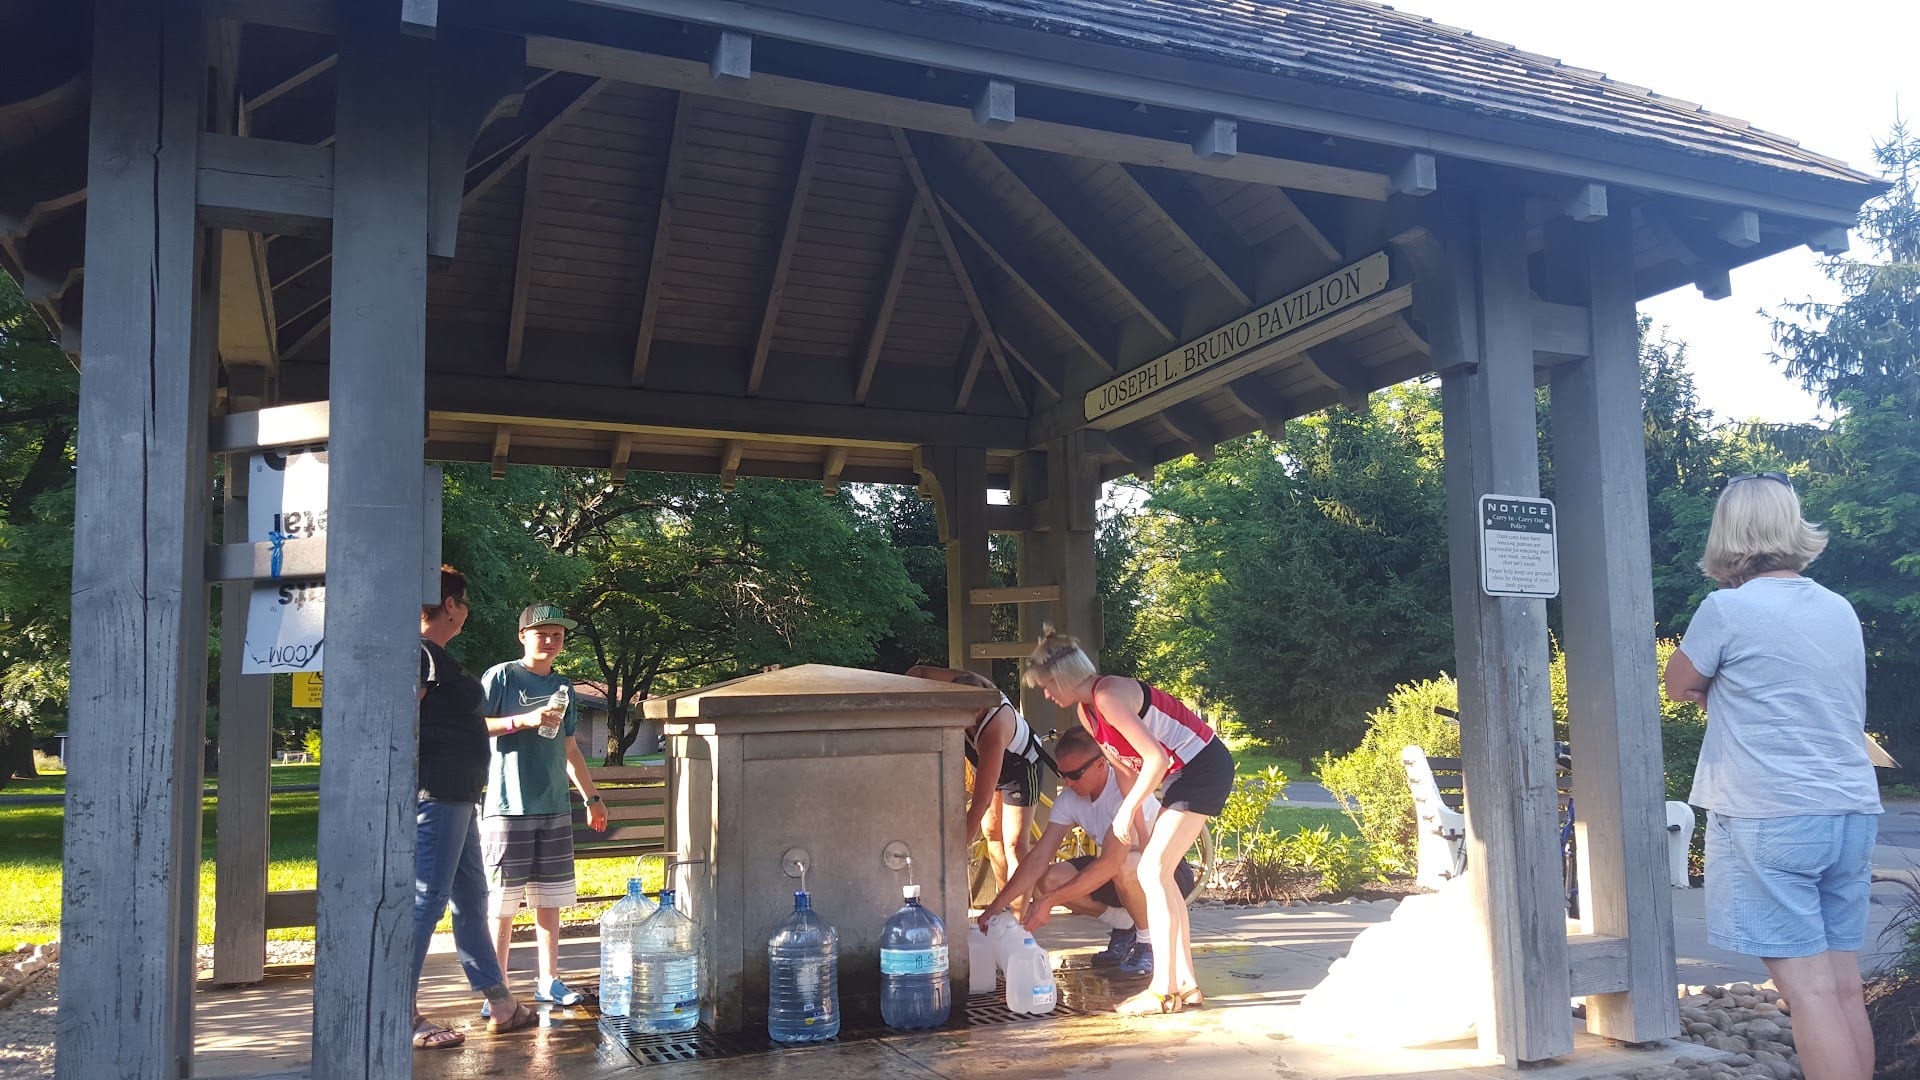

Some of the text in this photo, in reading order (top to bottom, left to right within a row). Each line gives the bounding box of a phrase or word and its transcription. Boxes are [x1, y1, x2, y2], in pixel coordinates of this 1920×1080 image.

[1098, 266, 1362, 412] JOSEPH L. BRUNO PAVILION
[1487, 503, 1549, 516] NOTICE
[1492, 514, 1507, 522] Carry
[1518, 516, 1533, 524] Carry
